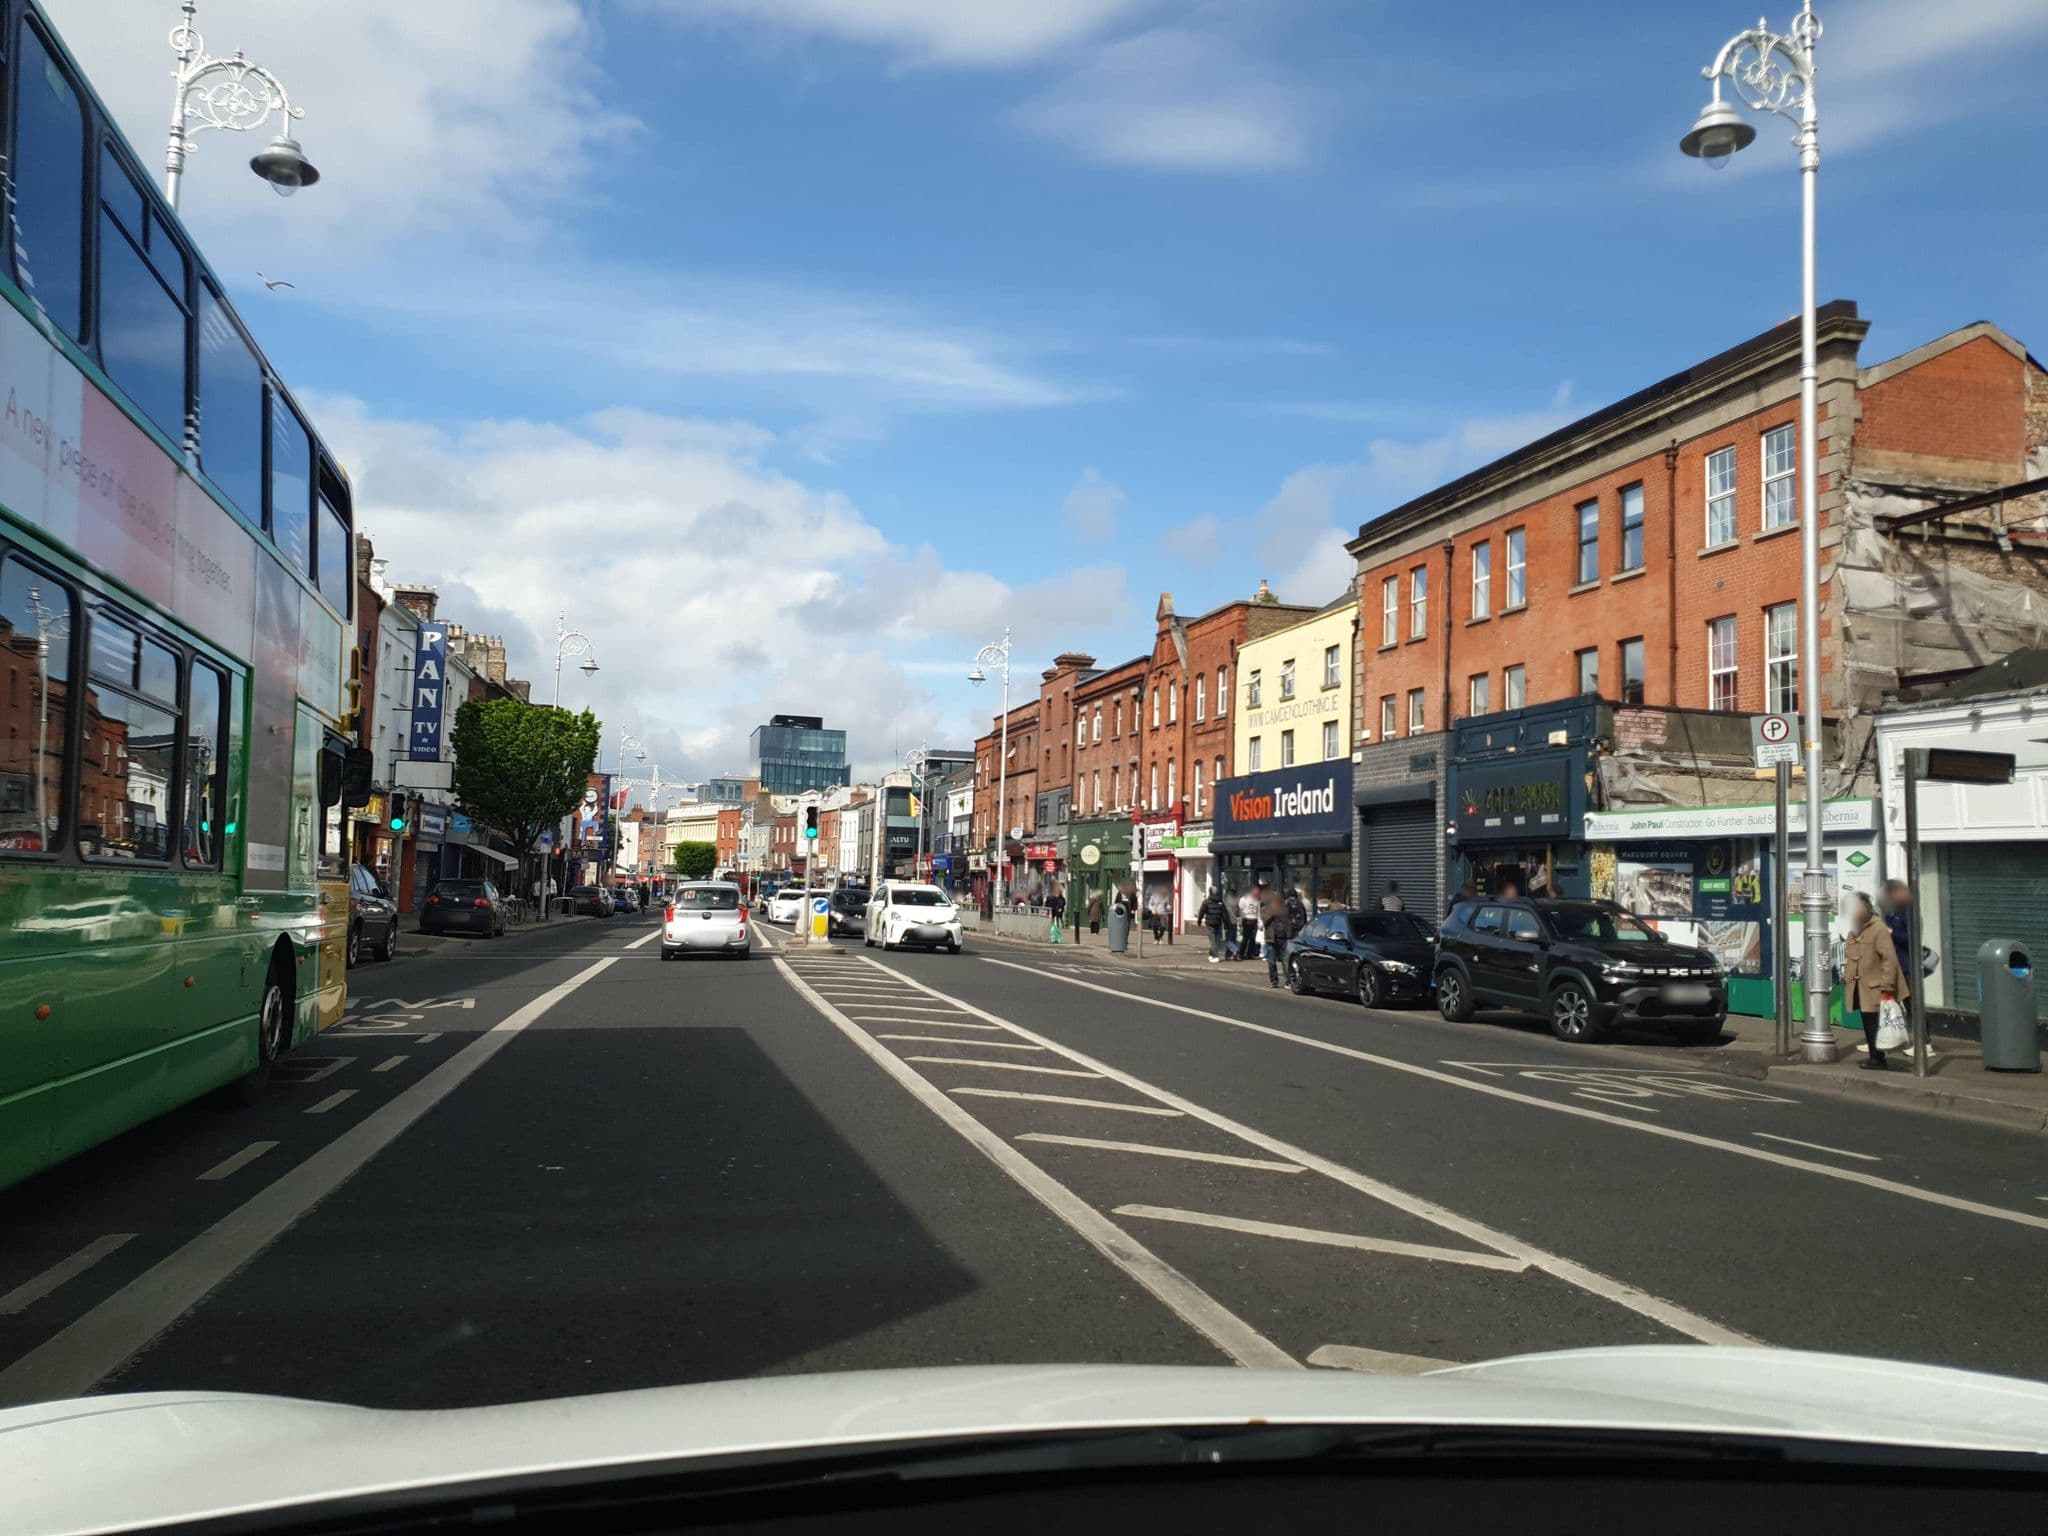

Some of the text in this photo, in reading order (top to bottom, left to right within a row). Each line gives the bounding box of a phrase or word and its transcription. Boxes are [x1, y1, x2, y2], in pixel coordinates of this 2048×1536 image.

[5, 385, 19, 429] A
[418, 631, 442, 709] PAN
[414, 721, 438, 734] TV
[1230, 778, 1334, 822] Vision Ireland
[1630, 820, 1647, 830] John
[1647, 820, 1663, 829] Paul
[1705, 818, 1716, 827] Go
[1748, 814, 1766, 825] Build
